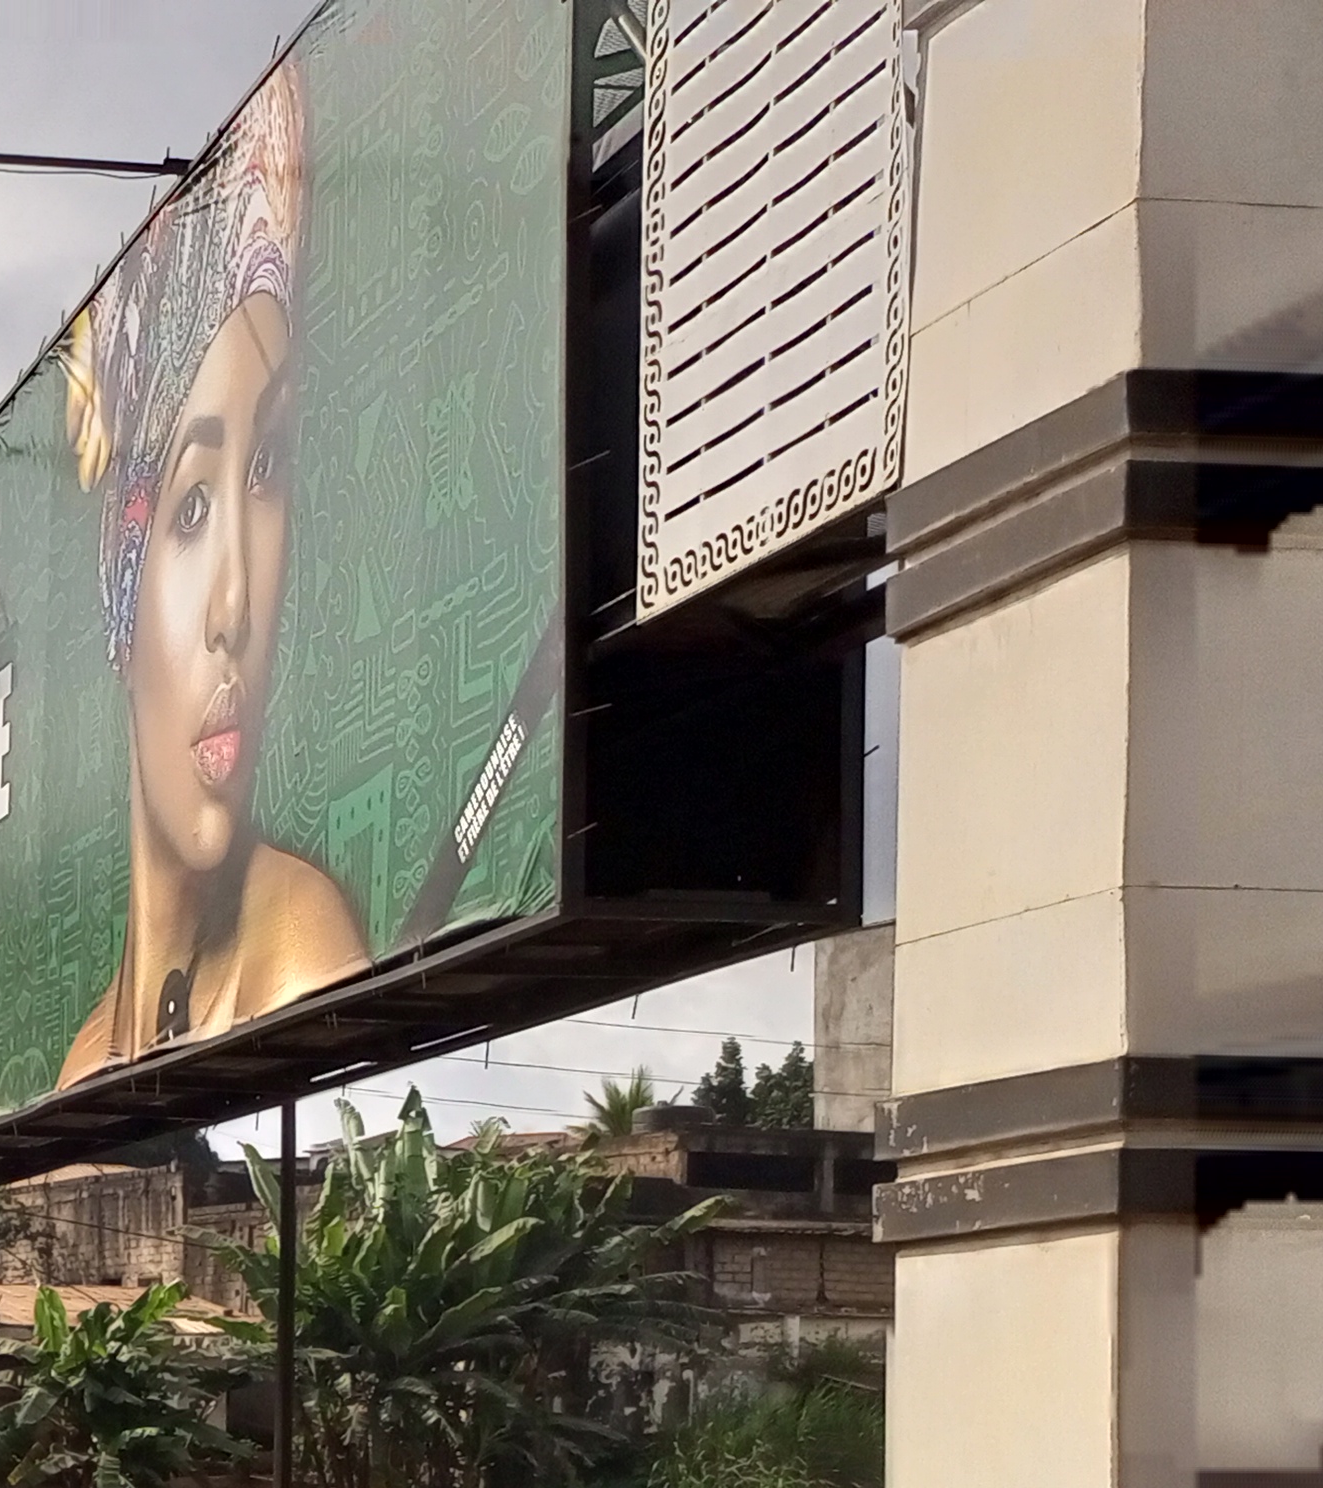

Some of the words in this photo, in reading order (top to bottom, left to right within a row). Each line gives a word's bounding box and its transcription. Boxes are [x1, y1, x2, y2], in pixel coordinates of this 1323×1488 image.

[454, 713, 517, 843] CAMEROUNAISE
[457, 838, 470, 864] ET
[485, 780, 499, 807] DE
